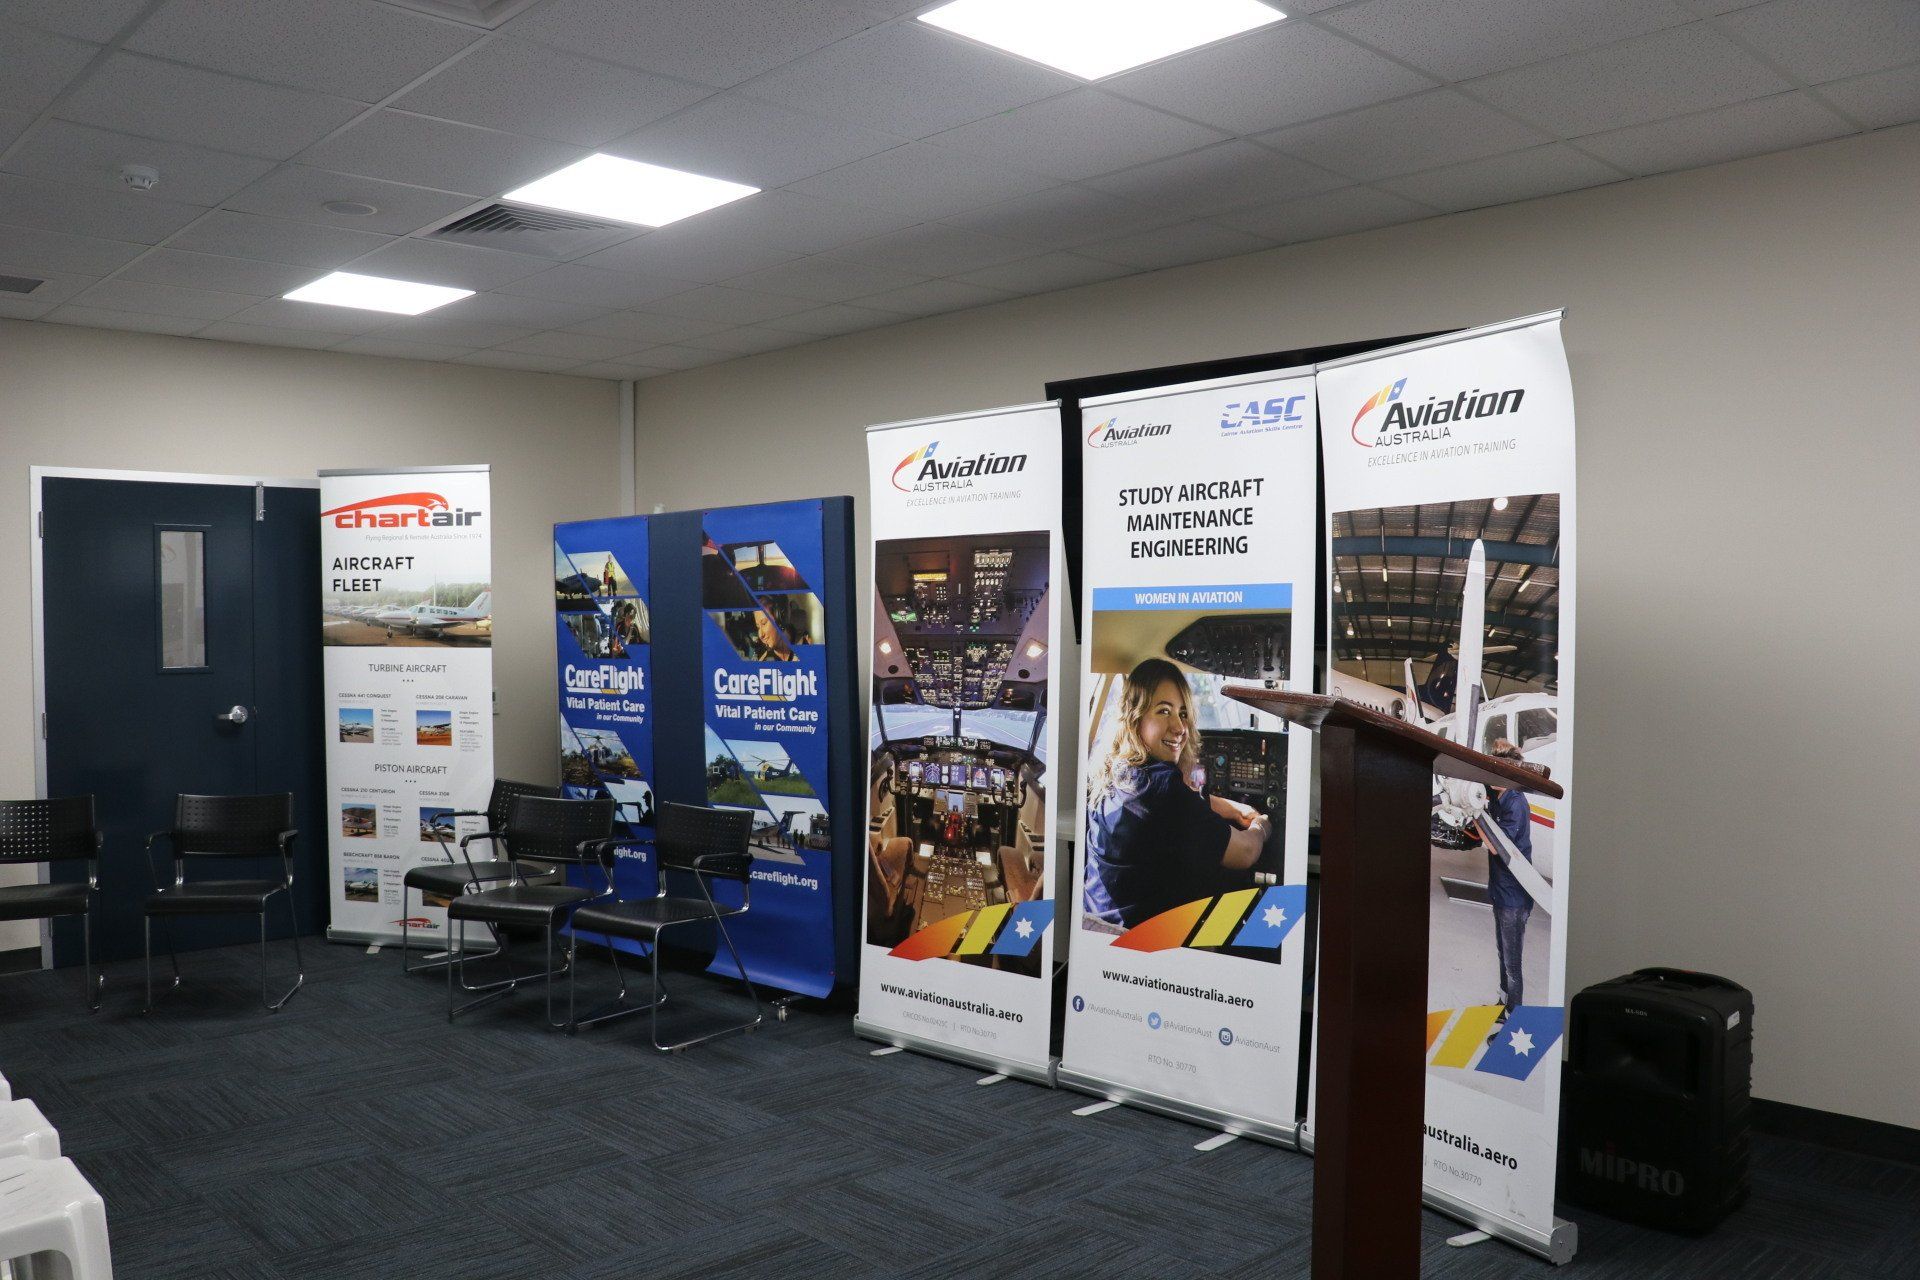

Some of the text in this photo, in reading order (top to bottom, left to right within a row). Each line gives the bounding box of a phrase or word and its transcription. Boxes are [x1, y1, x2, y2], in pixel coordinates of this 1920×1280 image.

[1380, 388, 1525, 433] Aviation
[1103, 422, 1172, 442] Aviation
[1375, 426, 1452, 448] AUSTRALIA
[1100, 439, 1138, 449] AUSTRALIA
[1367, 438, 1517, 468] EXCELLENCE IN AVIATION TRAINING
[917, 452, 1028, 481] Aviation
[912, 479, 974, 493] AUSTRALIA
[1118, 477, 1265, 507] STUDY AIRCRAFT
[906, 489, 1022, 508] EXCELLENCE IN AVIATION TRAINING
[335, 508, 482, 529] chartair
[1126, 507, 1254, 533] MAINTENANCE
[365, 534, 381, 542] Flying
[382, 534, 403, 542] Regional
[1130, 535, 1249, 559] ENGINEERING
[332, 556, 415, 571] AIRCRAFT
[332, 578, 382, 592] FLEET
[1134, 591, 1243, 605] WOMEN IN AVIATION
[368, 663, 448, 673] TURBINE AIRCRAFT
[565, 664, 645, 694] CareFlight
[714, 667, 818, 701] CareFlight
[566, 696, 645, 713] Vital Patient Care
[715, 704, 819, 722] Vital Patient Care
[612, 713, 644, 724] Community
[754, 722, 761, 731] in
[775, 723, 817, 735] Community
[374, 763, 448, 775] PISTON AIRCRAFT
[1102, 968, 1255, 1010] www.aviationaustralia.aero
[880, 981, 1024, 1024] www.aviationaustralia.aero
[960, 1024, 972, 1034] RTO
[1163, 1020, 1213, 1039] @AviationAust
[1234, 1035, 1281, 1054] AviationAust
[1148, 1054, 1162, 1065] RTO
[1176, 1060, 1197, 1074] 30770
[1433, 1159, 1482, 1187] RTO No.30770
